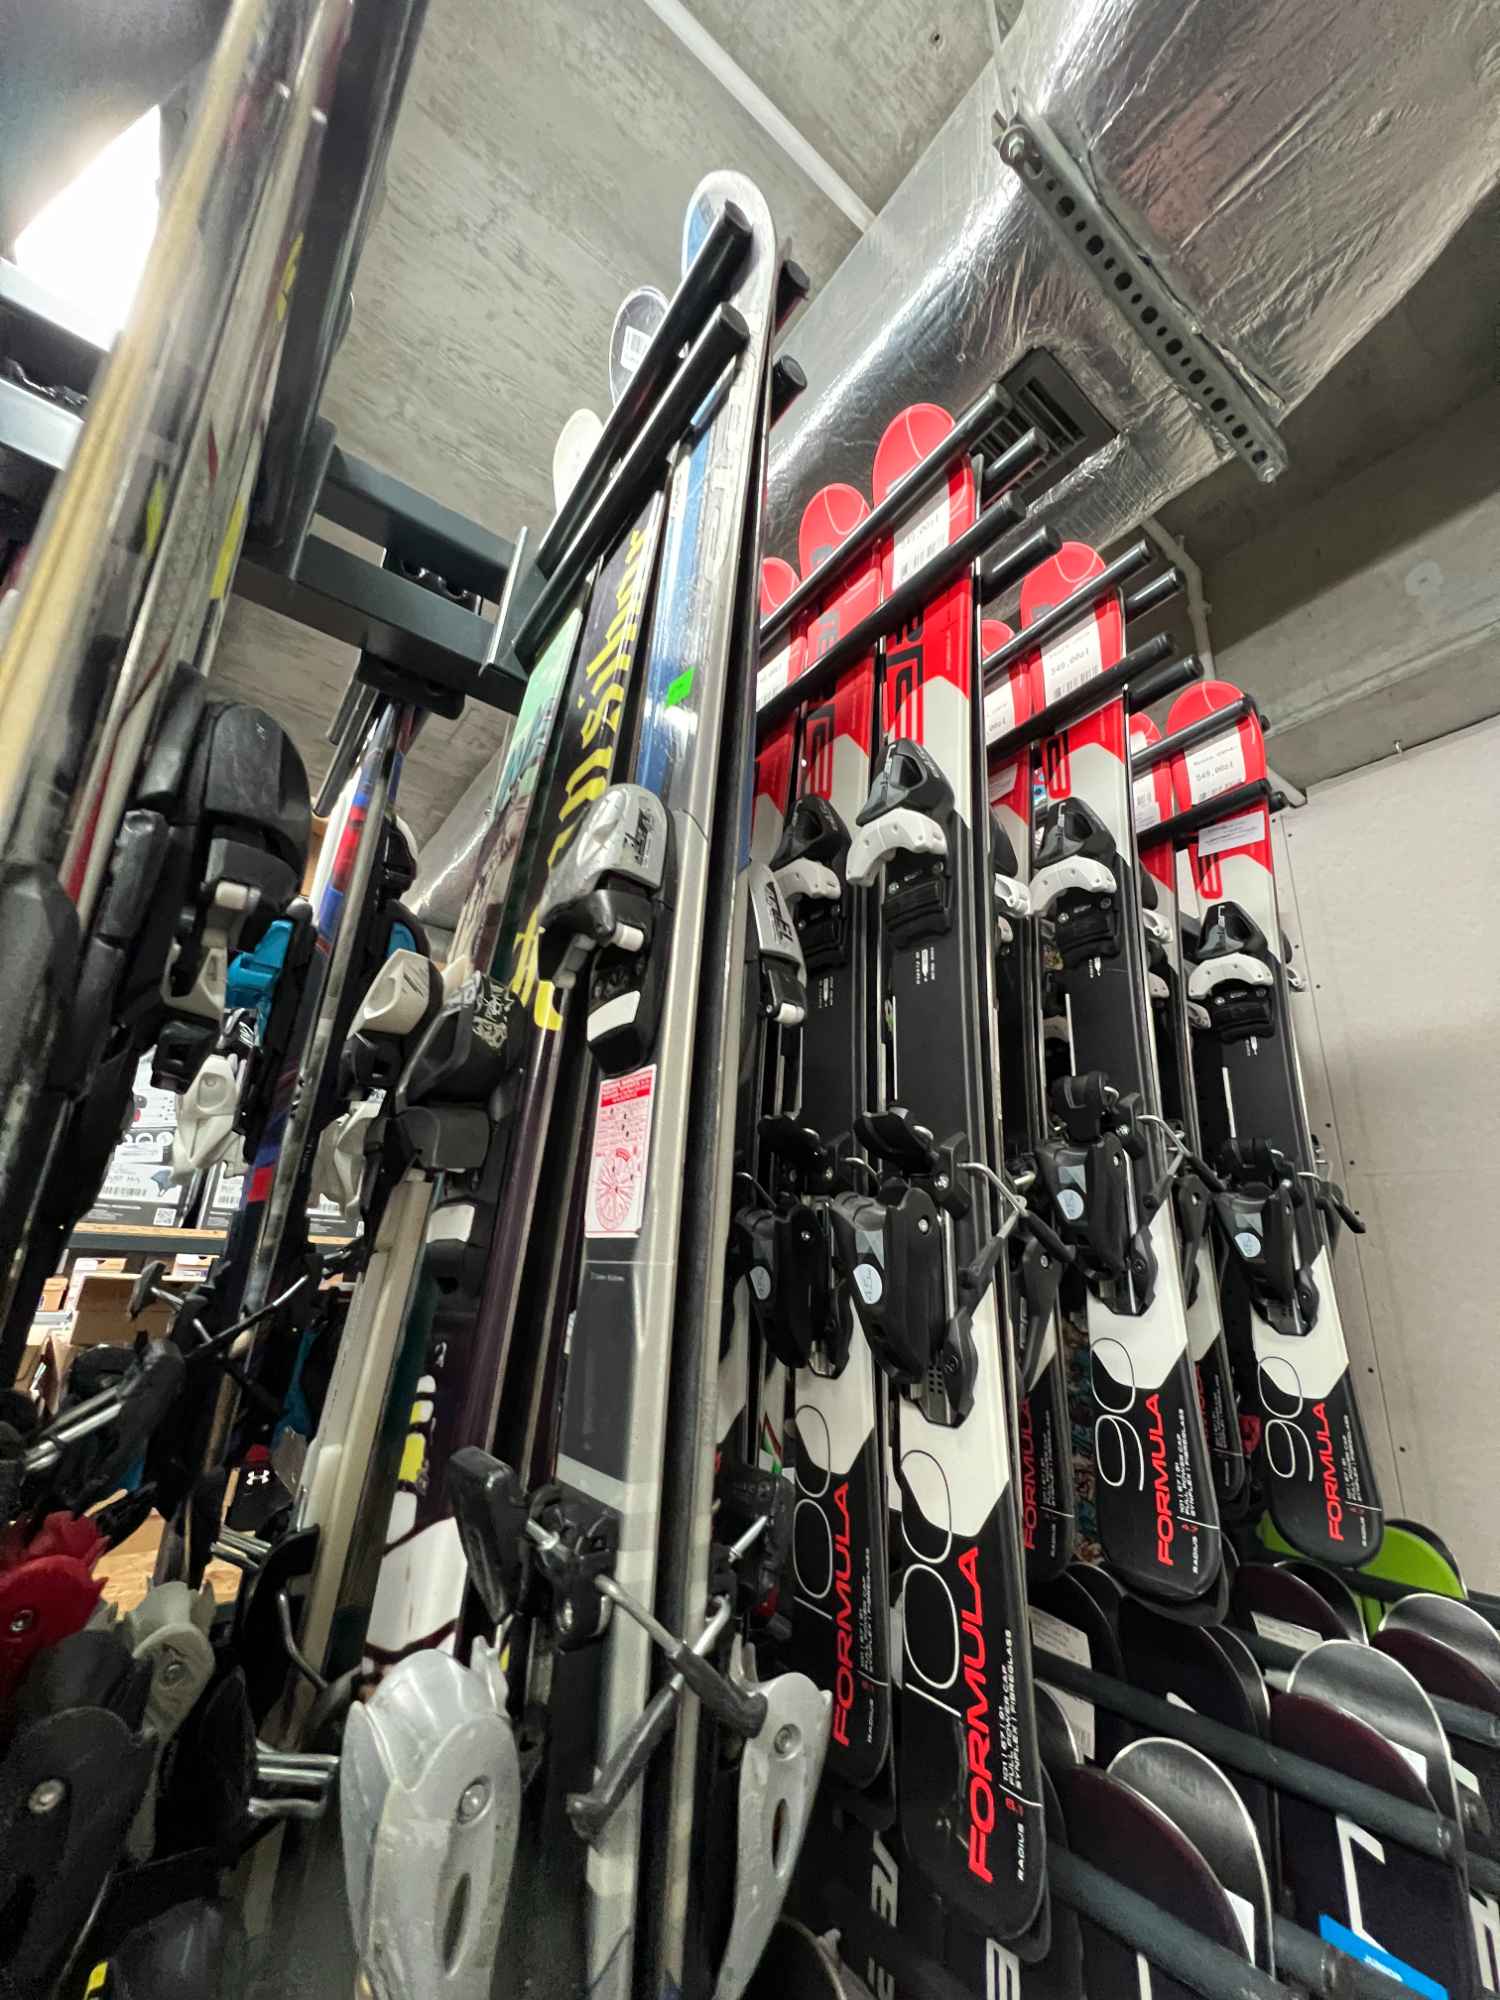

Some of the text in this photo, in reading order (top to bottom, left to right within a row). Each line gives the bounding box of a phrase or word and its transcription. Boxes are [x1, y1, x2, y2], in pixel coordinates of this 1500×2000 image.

[1020, 1393, 1038, 1550] FORMULA
[1145, 1392, 1175, 1567] FORMULA
[1312, 1401, 1345, 1542] FORMULA
[833, 1481, 855, 1747] FORMULA
[1191, 1535, 1200, 1575] RADIUS
[957, 1546, 995, 1885] FORMULA
[1003, 1695, 1013, 1748] POWER
[1004, 1629, 1017, 1714] FIBREGLASS
[1016, 1822, 1025, 1881] RADIUS
